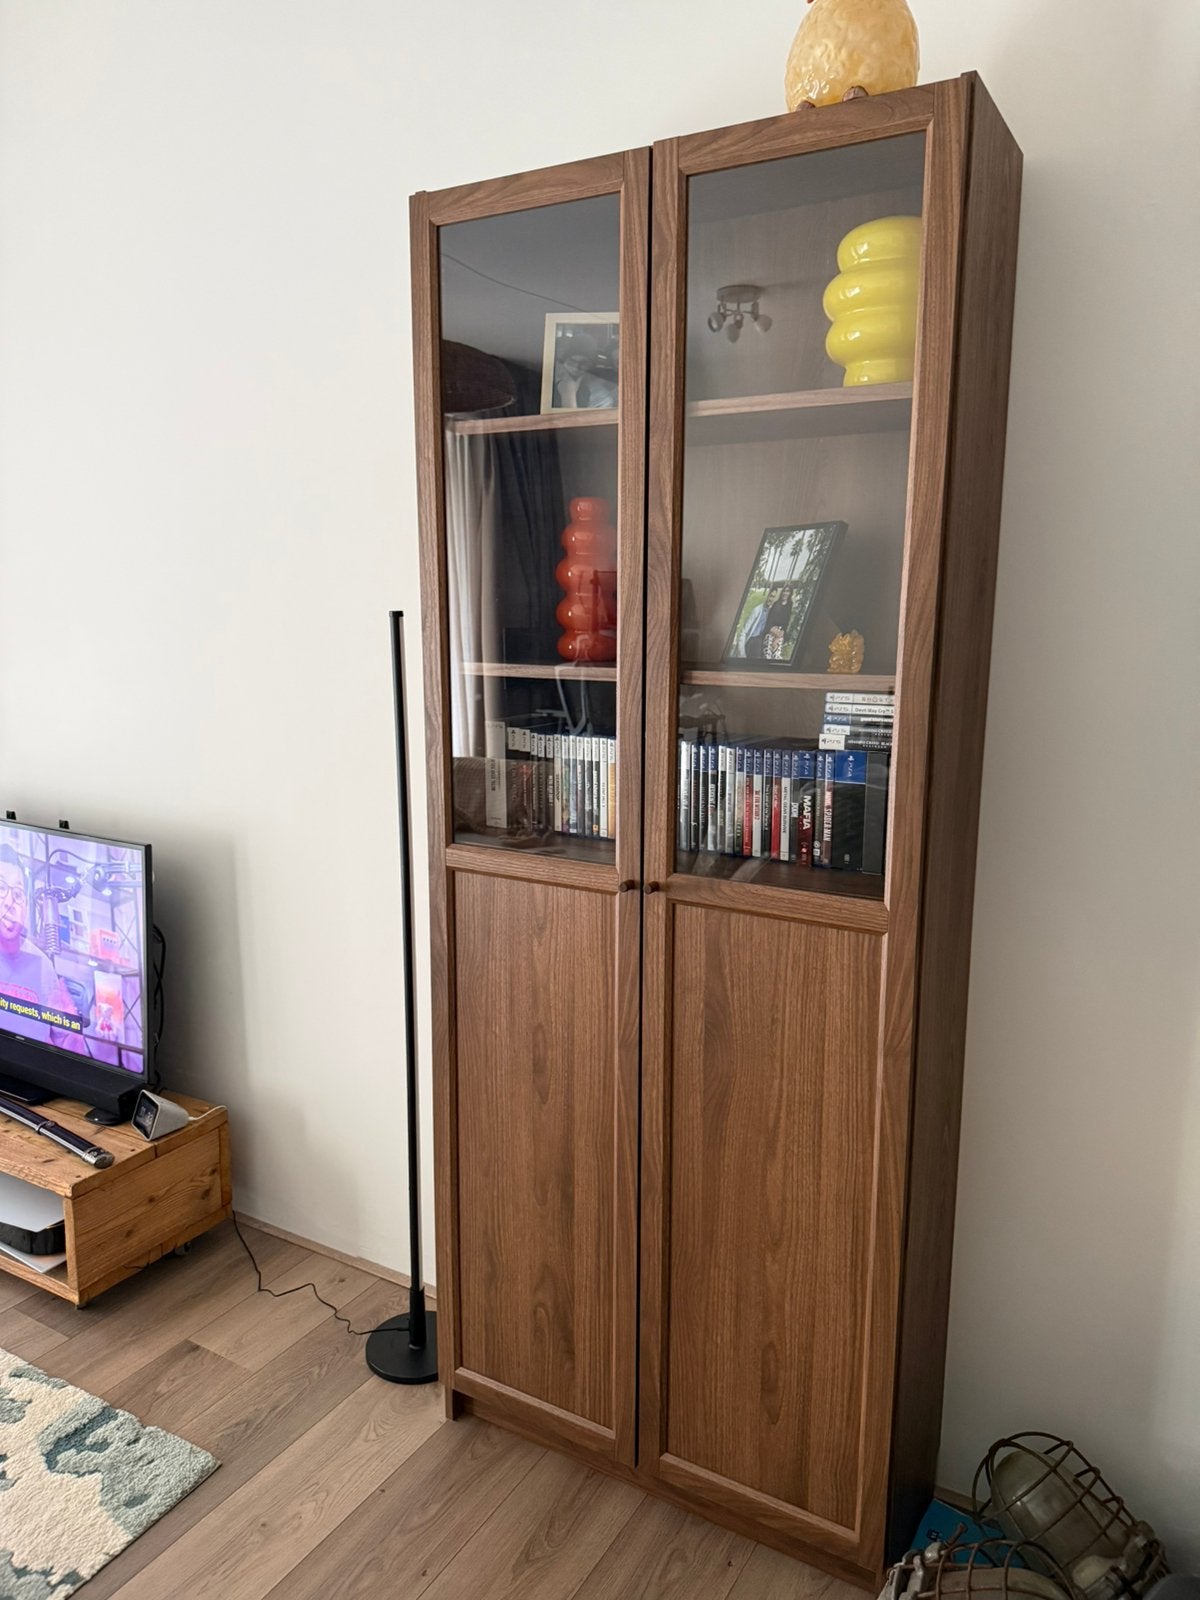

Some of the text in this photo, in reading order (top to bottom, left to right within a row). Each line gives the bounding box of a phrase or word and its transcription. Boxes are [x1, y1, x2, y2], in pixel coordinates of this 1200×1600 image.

[803, 795, 812, 830] MAFIA
[823, 808, 832, 842] SPIDER-MAN
[10, 1002, 41, 1020] requests,
[41, 1011, 63, 1025] which
[63, 1016, 70, 1027] is
[71, 1021, 81, 1031] an
